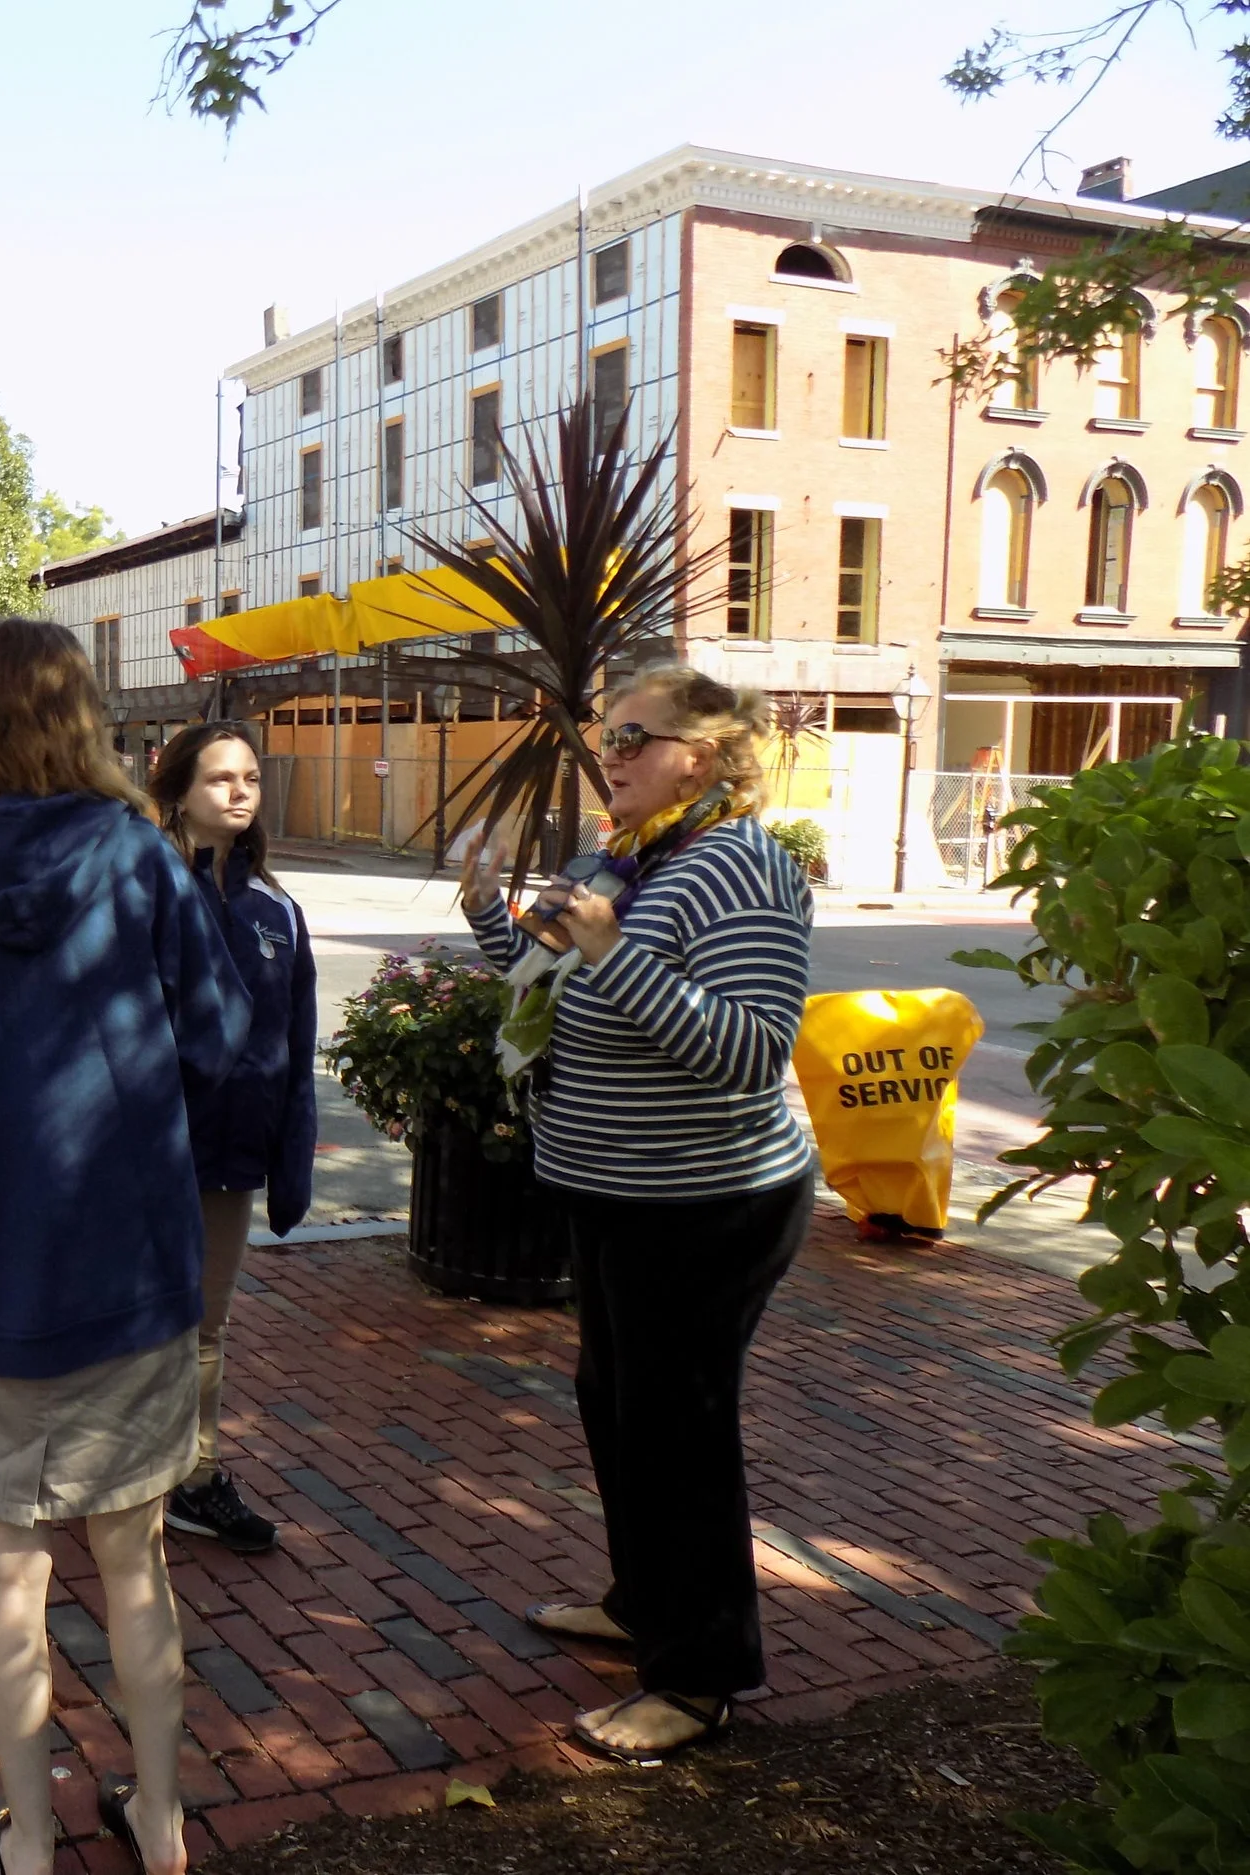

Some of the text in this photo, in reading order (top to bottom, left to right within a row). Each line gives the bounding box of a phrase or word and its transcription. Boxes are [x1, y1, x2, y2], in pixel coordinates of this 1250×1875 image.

[842, 1046, 955, 1077] OUT OF
[838, 1077, 950, 1109] SERVIC
